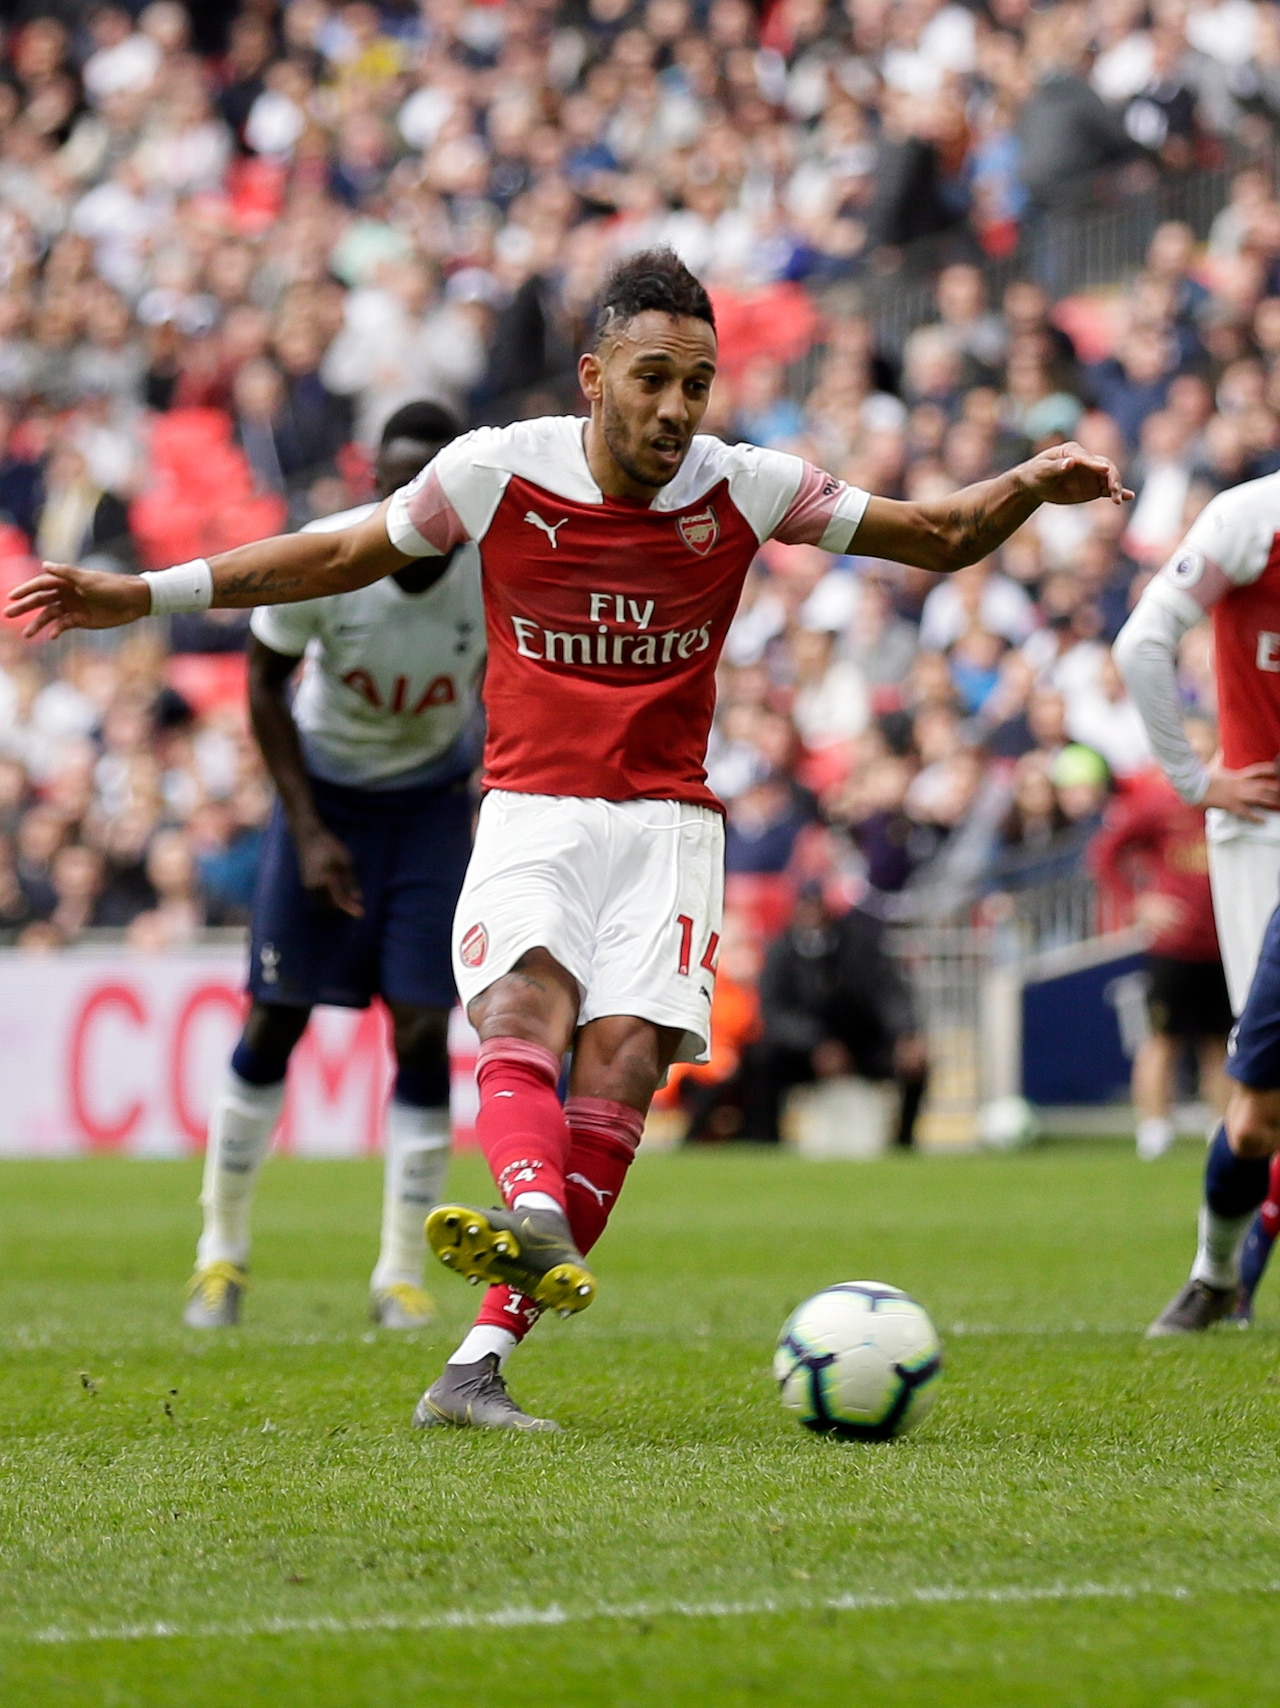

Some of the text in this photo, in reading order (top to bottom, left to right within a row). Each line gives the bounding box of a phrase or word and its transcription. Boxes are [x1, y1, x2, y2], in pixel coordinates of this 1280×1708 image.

[590, 592, 655, 630] Fly
[510, 616, 713, 665] Emirates
[341, 667, 458, 717] AIA
